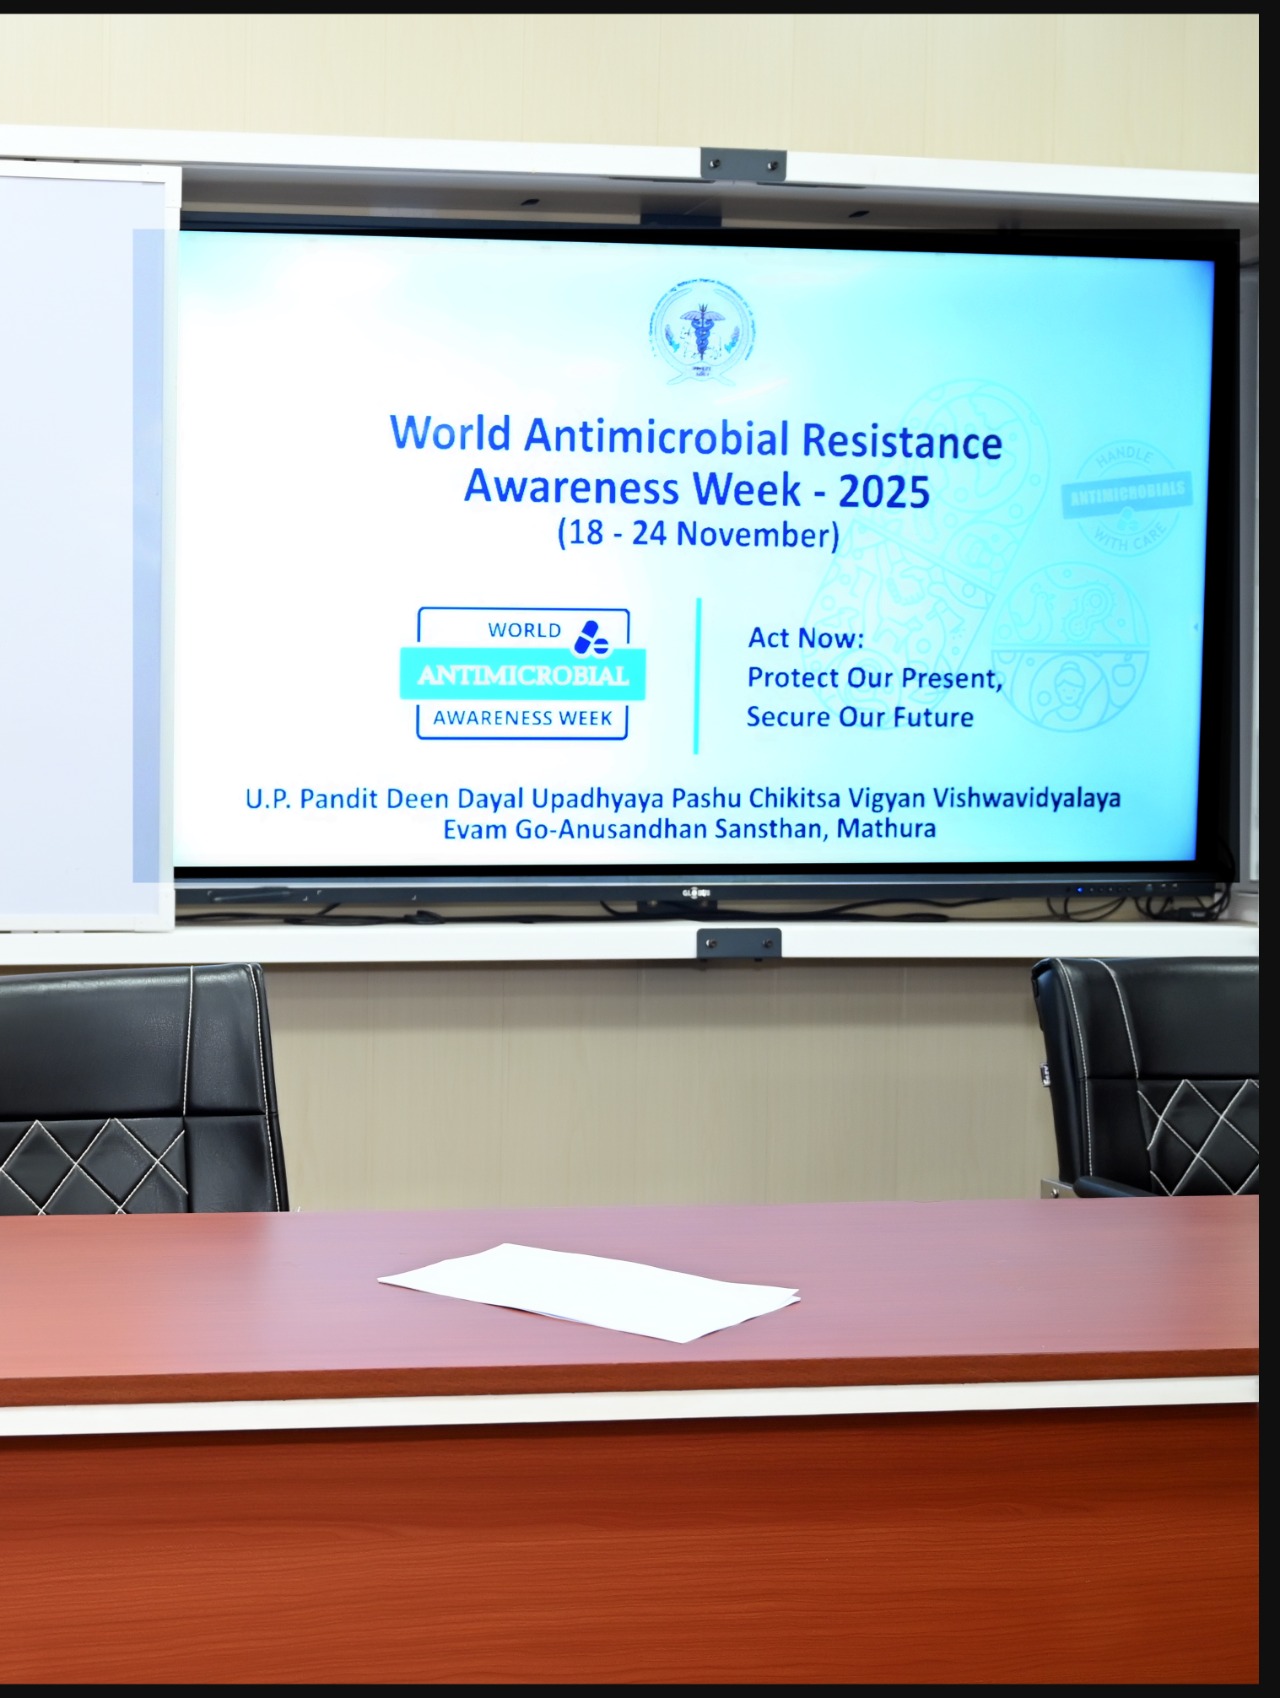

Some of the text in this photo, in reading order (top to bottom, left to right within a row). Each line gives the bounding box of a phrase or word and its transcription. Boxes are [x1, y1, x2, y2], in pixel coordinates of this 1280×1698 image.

[389, 413, 1003, 461] World Antimicrobial Resistance
[1095, 446, 1154, 468] HANDLE
[463, 467, 680, 505] Awareness
[692, 470, 801, 507] Week
[839, 473, 930, 509] 2025
[1070, 480, 1185, 506] ANTIMICROBIALS
[558, 516, 603, 551] (18
[632, 519, 667, 546] 24
[677, 519, 840, 554] November)
[1093, 521, 1167, 551] WITH CARE
[488, 622, 561, 638] WORLD
[748, 626, 864, 649] Act Now:
[417, 664, 630, 686] ANTIMICROBIAL
[748, 666, 1003, 693] Protect Our Present,
[433, 710, 612, 726] AWARENESS WEEK
[747, 705, 974, 728] Secure Our Future
[246, 785, 1121, 814] U.P. Pandit Deen Dayal Upadhyaya Pashu Chikitsa Vigyan Vishwavidyalaya
[444, 816, 936, 842] Evam Go-Anusandhan Sansthan, Mathura
